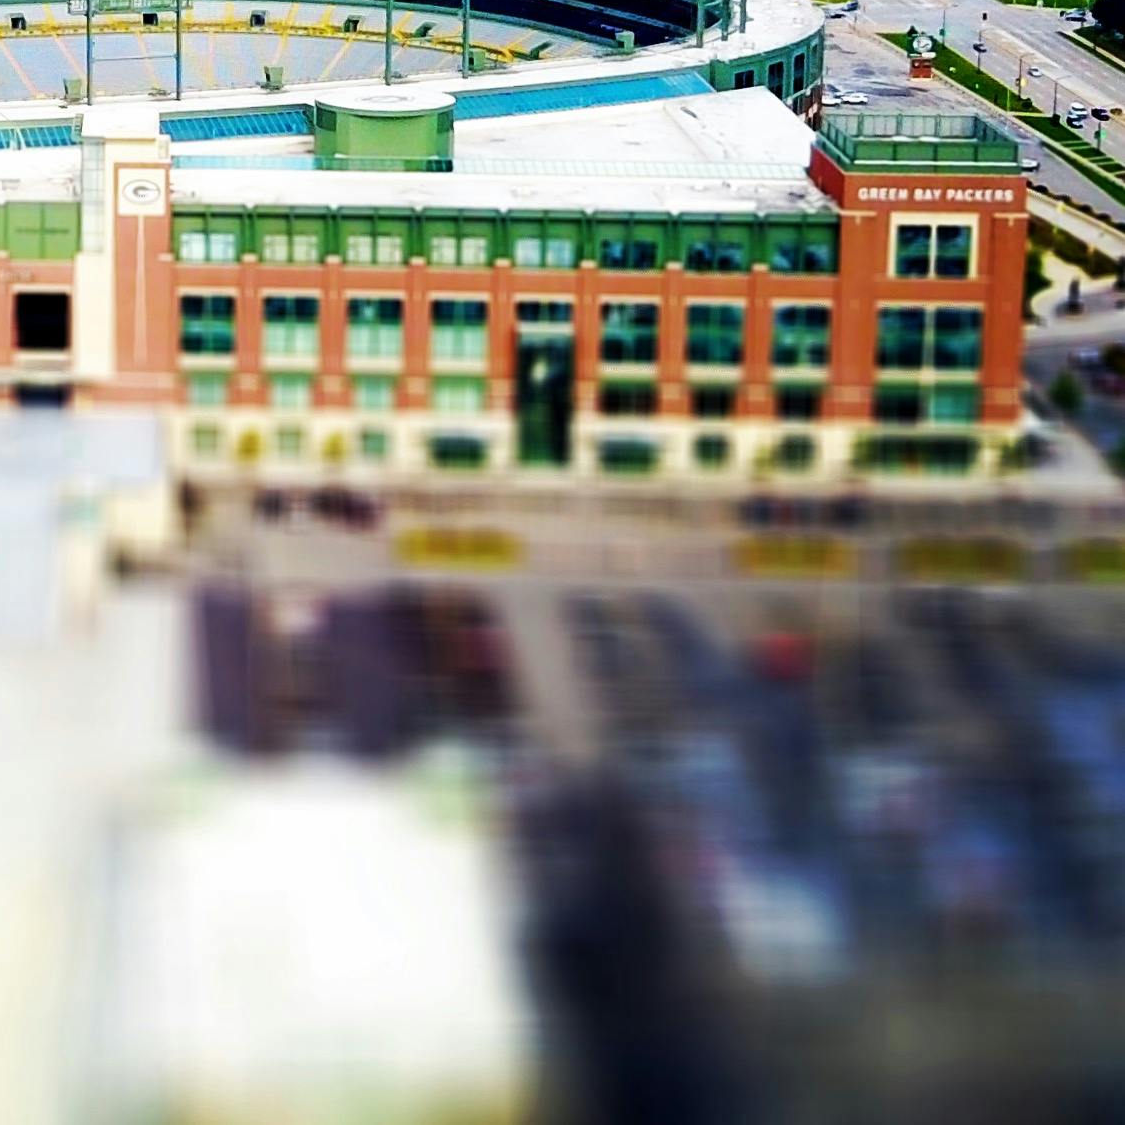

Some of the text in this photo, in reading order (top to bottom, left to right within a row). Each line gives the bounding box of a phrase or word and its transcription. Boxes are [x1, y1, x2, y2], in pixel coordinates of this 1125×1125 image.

[858, 187, 1014, 202] GREEN BAY PACKERS
